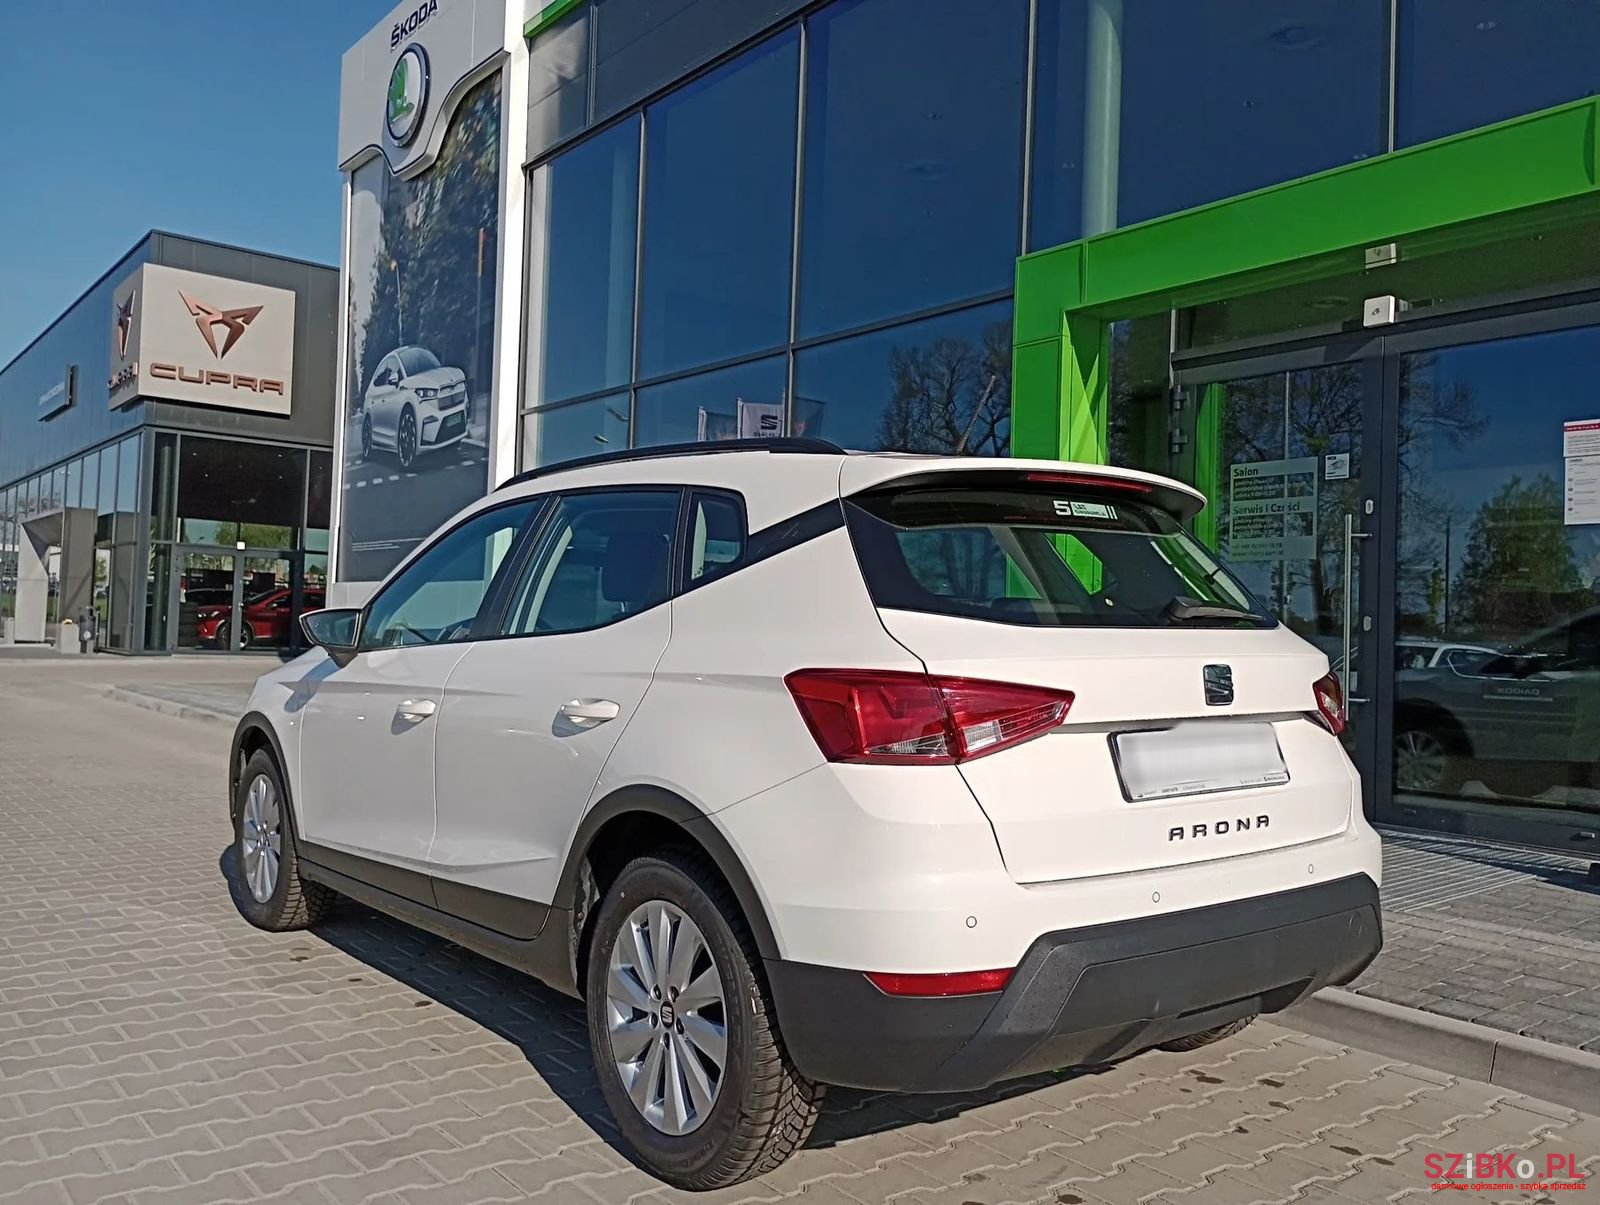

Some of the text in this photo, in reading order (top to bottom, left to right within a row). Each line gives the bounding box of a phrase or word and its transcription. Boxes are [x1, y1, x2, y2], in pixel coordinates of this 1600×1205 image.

[391, 0, 438, 47] ŠKODA
[150, 362, 284, 396] CUPRA
[1233, 467, 1259, 477] Salon
[1233, 503, 1264, 514] Serwis
[1168, 815, 1270, 842] ARONA
